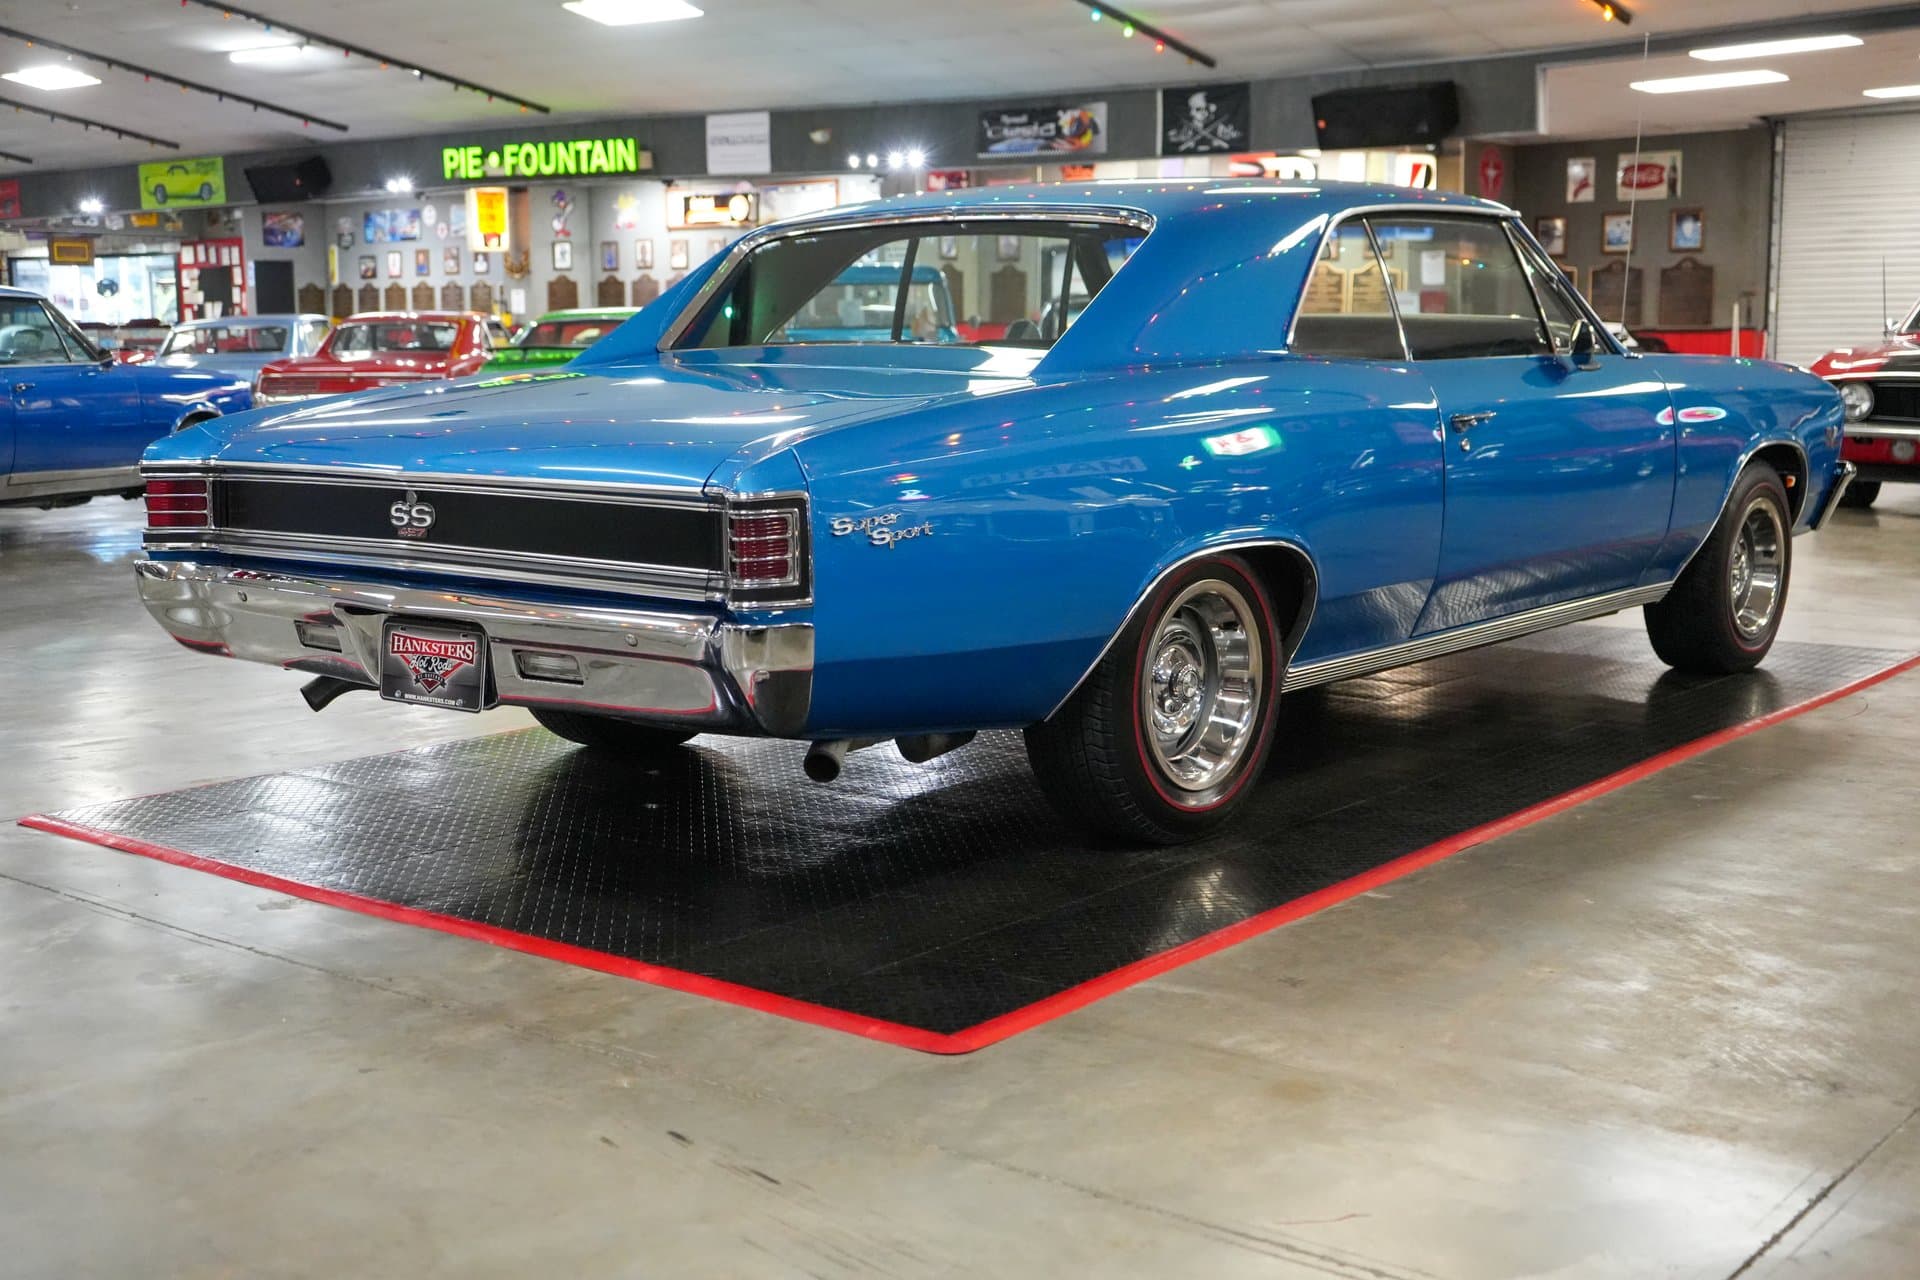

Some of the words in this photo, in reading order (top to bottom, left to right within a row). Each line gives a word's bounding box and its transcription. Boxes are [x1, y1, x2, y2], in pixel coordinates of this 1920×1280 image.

[443, 147, 483, 179] PIE
[503, 138, 637, 176] FOUNTAIN
[390, 501, 434, 528] SS
[831, 512, 901, 535] Super
[871, 521, 933, 549] Sport
[393, 635, 474, 661] HANKSTERS
[409, 655, 428, 670] Hot
[428, 656, 453, 674] Rods
